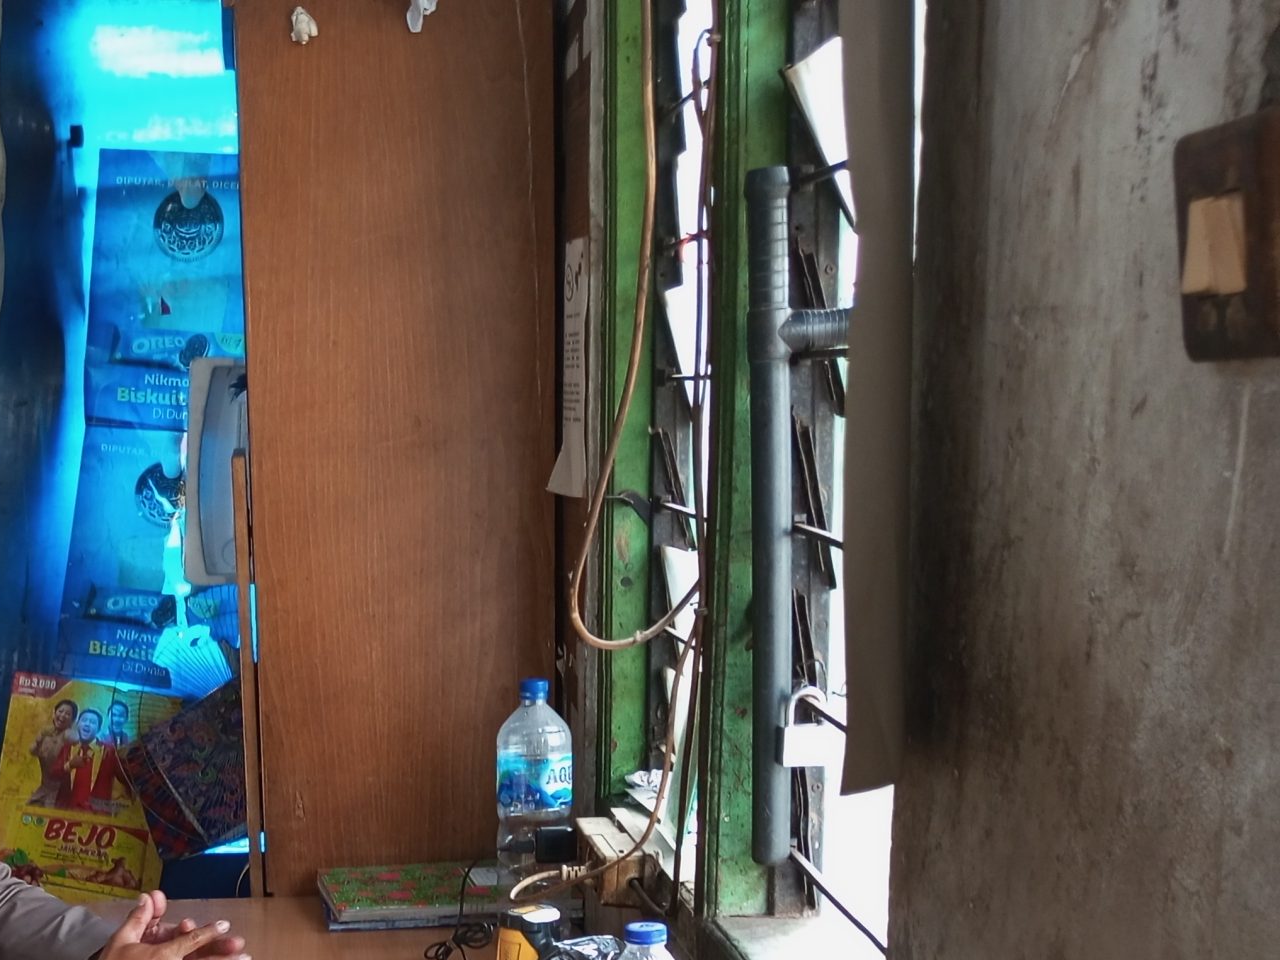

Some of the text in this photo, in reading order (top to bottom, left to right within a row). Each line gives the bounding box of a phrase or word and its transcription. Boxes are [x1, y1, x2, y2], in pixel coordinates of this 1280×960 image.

[132, 336, 185, 354] OREO
[117, 387, 187, 406] Biskuit
[152, 408, 164, 419] Di
[106, 595, 158, 610] OREO
[44, 818, 116, 850] BEJO
